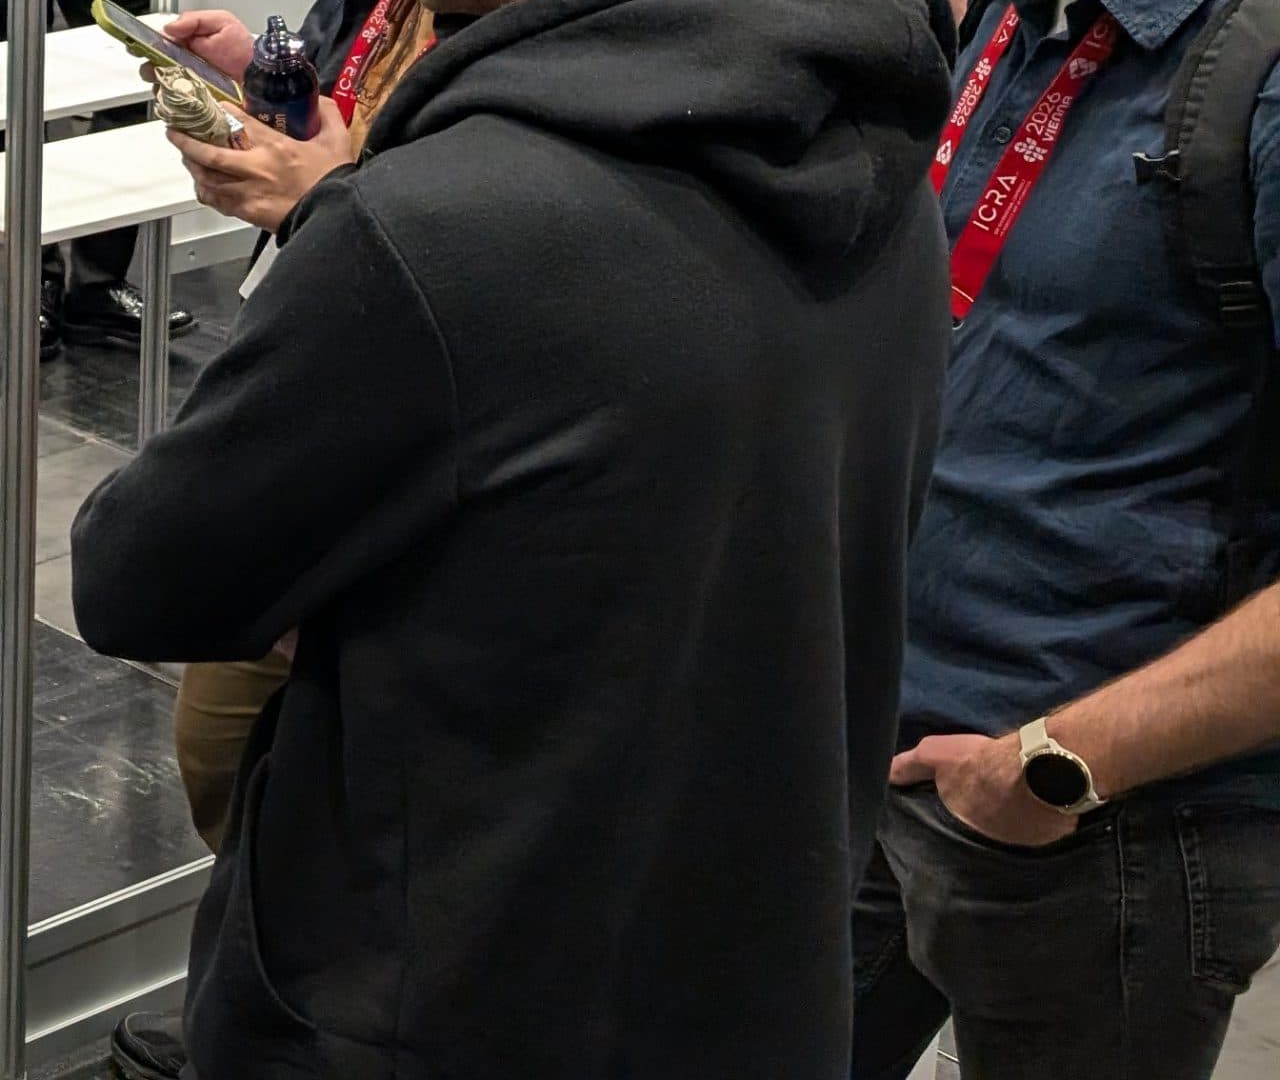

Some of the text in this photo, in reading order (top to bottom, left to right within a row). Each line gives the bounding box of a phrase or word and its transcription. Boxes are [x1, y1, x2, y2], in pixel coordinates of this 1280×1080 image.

[957, 86, 982, 126] 2026
[1026, 92, 1061, 136] 2026
[972, 176, 1017, 231] ICRA
